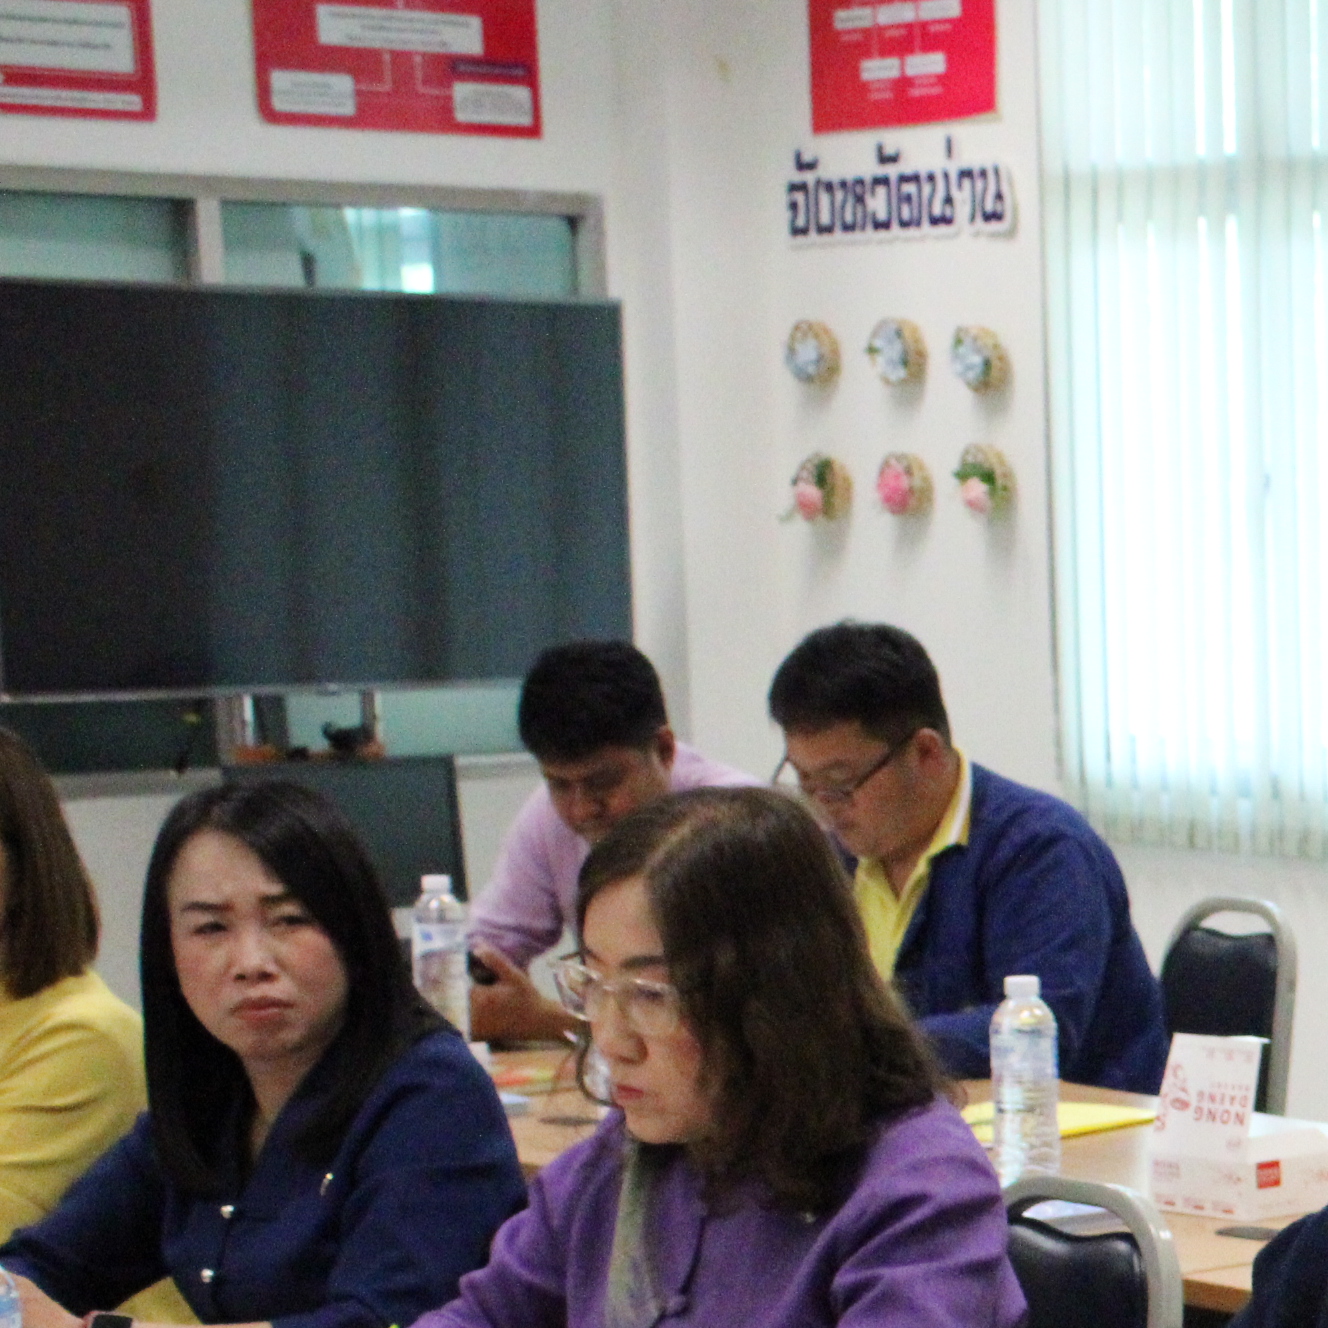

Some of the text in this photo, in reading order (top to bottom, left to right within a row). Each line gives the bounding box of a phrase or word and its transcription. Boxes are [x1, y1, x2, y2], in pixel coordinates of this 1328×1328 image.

[787, 134, 1004, 237] จังหวัดน่าน
[1194, 1107, 1246, 1127] NONG
